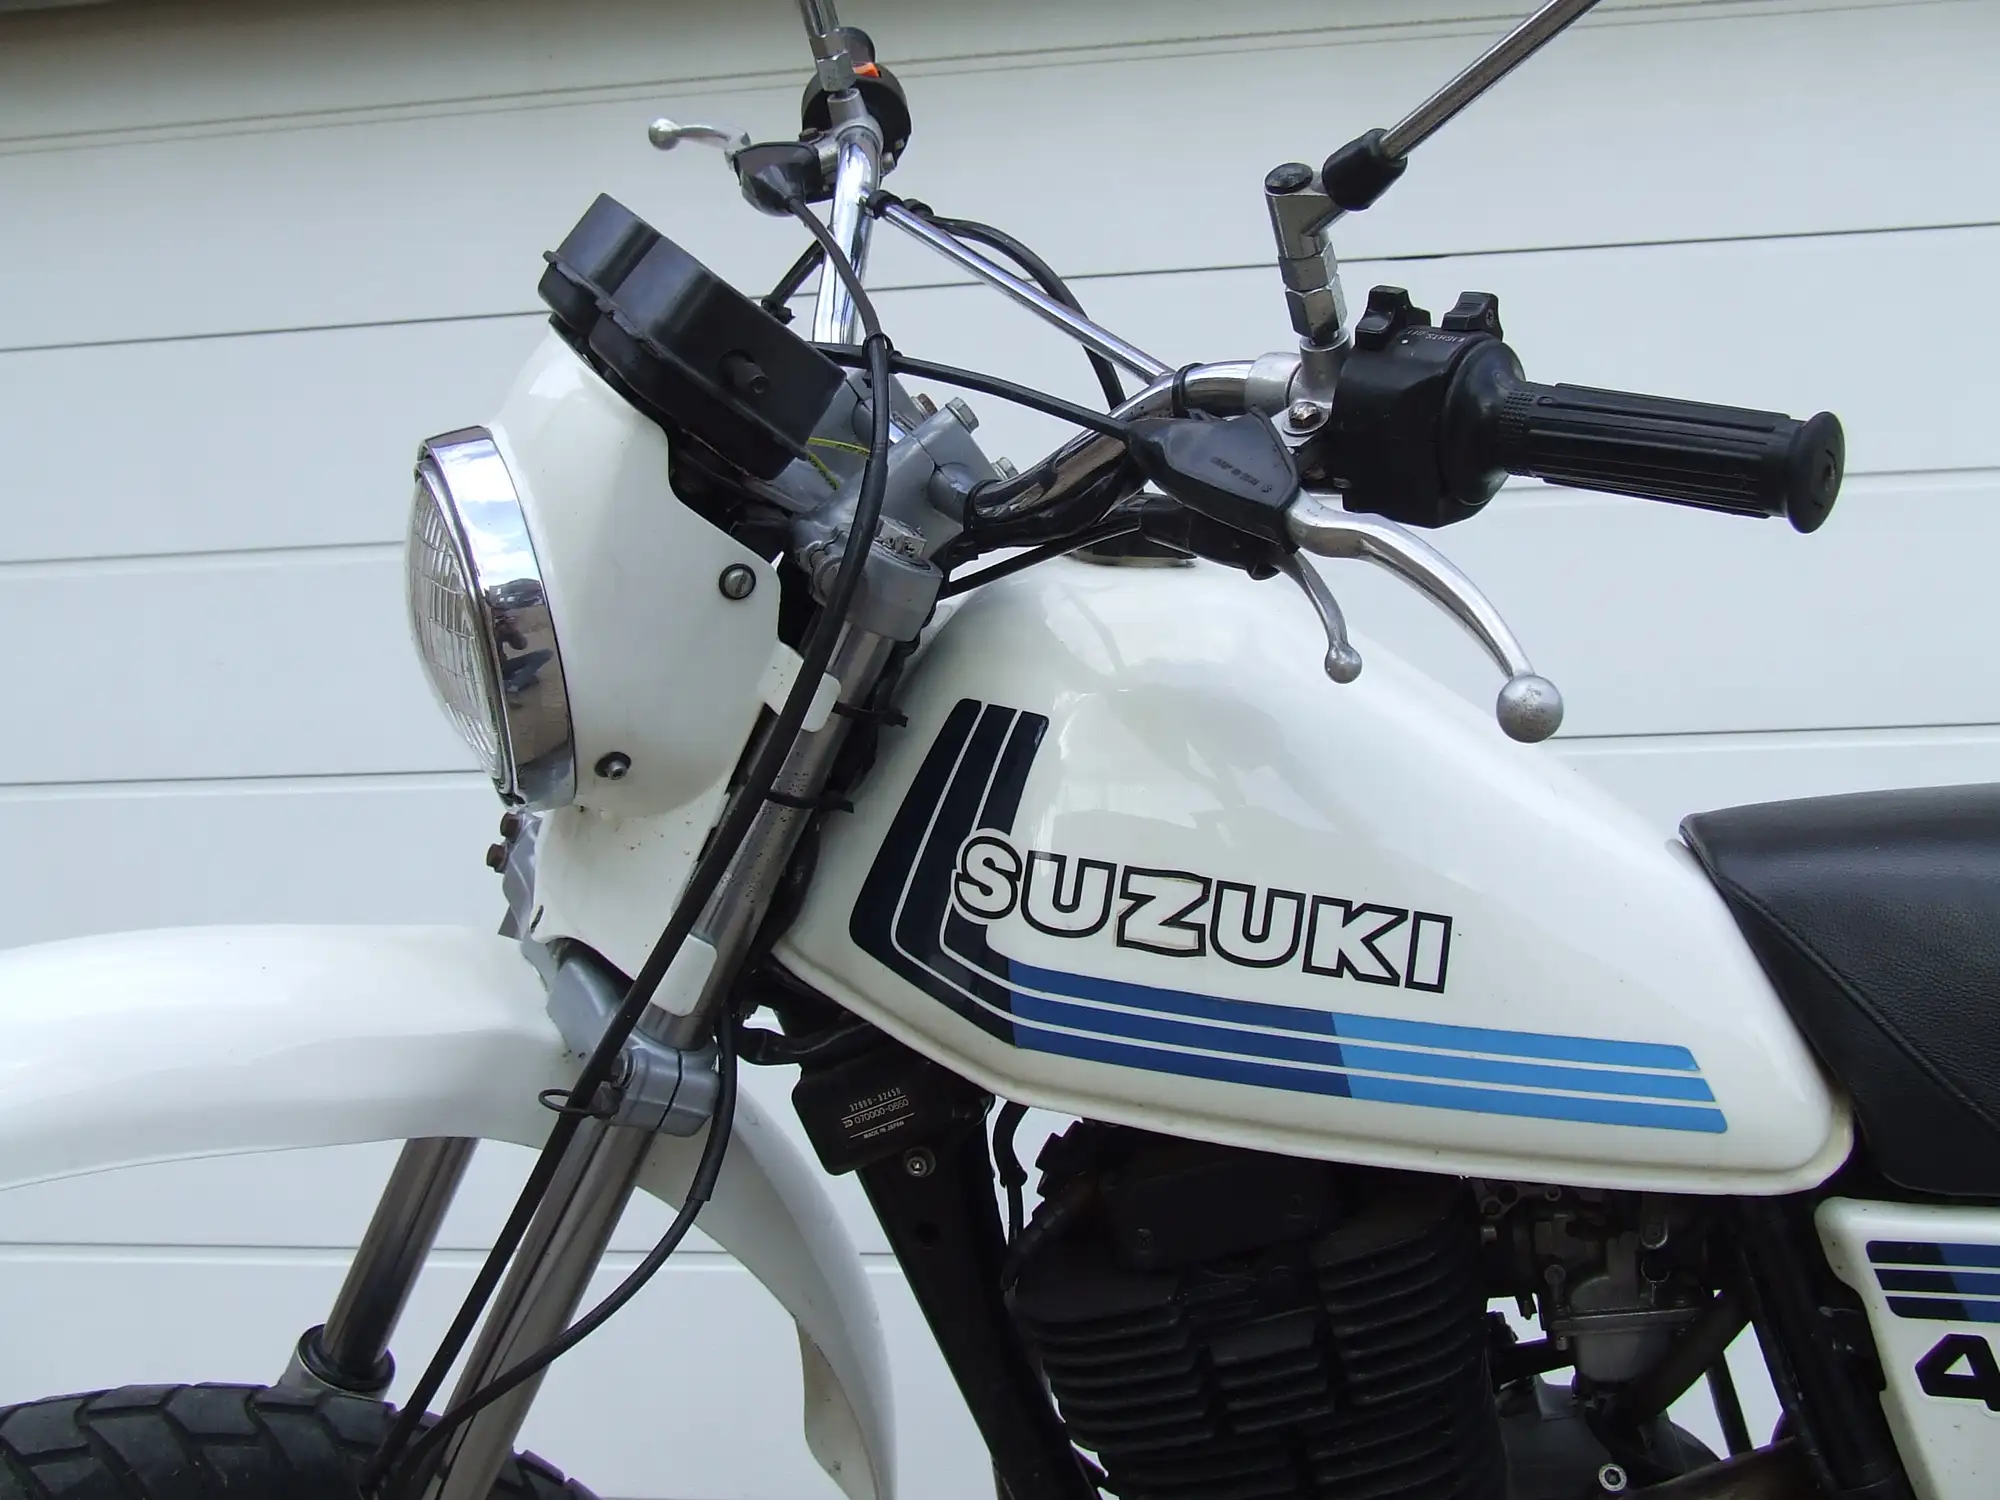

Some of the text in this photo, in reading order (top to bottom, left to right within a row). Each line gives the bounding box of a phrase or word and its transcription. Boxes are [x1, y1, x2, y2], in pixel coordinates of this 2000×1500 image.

[954, 835, 1452, 994] SUZUKI
[887, 1120, 905, 1132] JAPAN
[1914, 1333, 2000, 1412] 4
